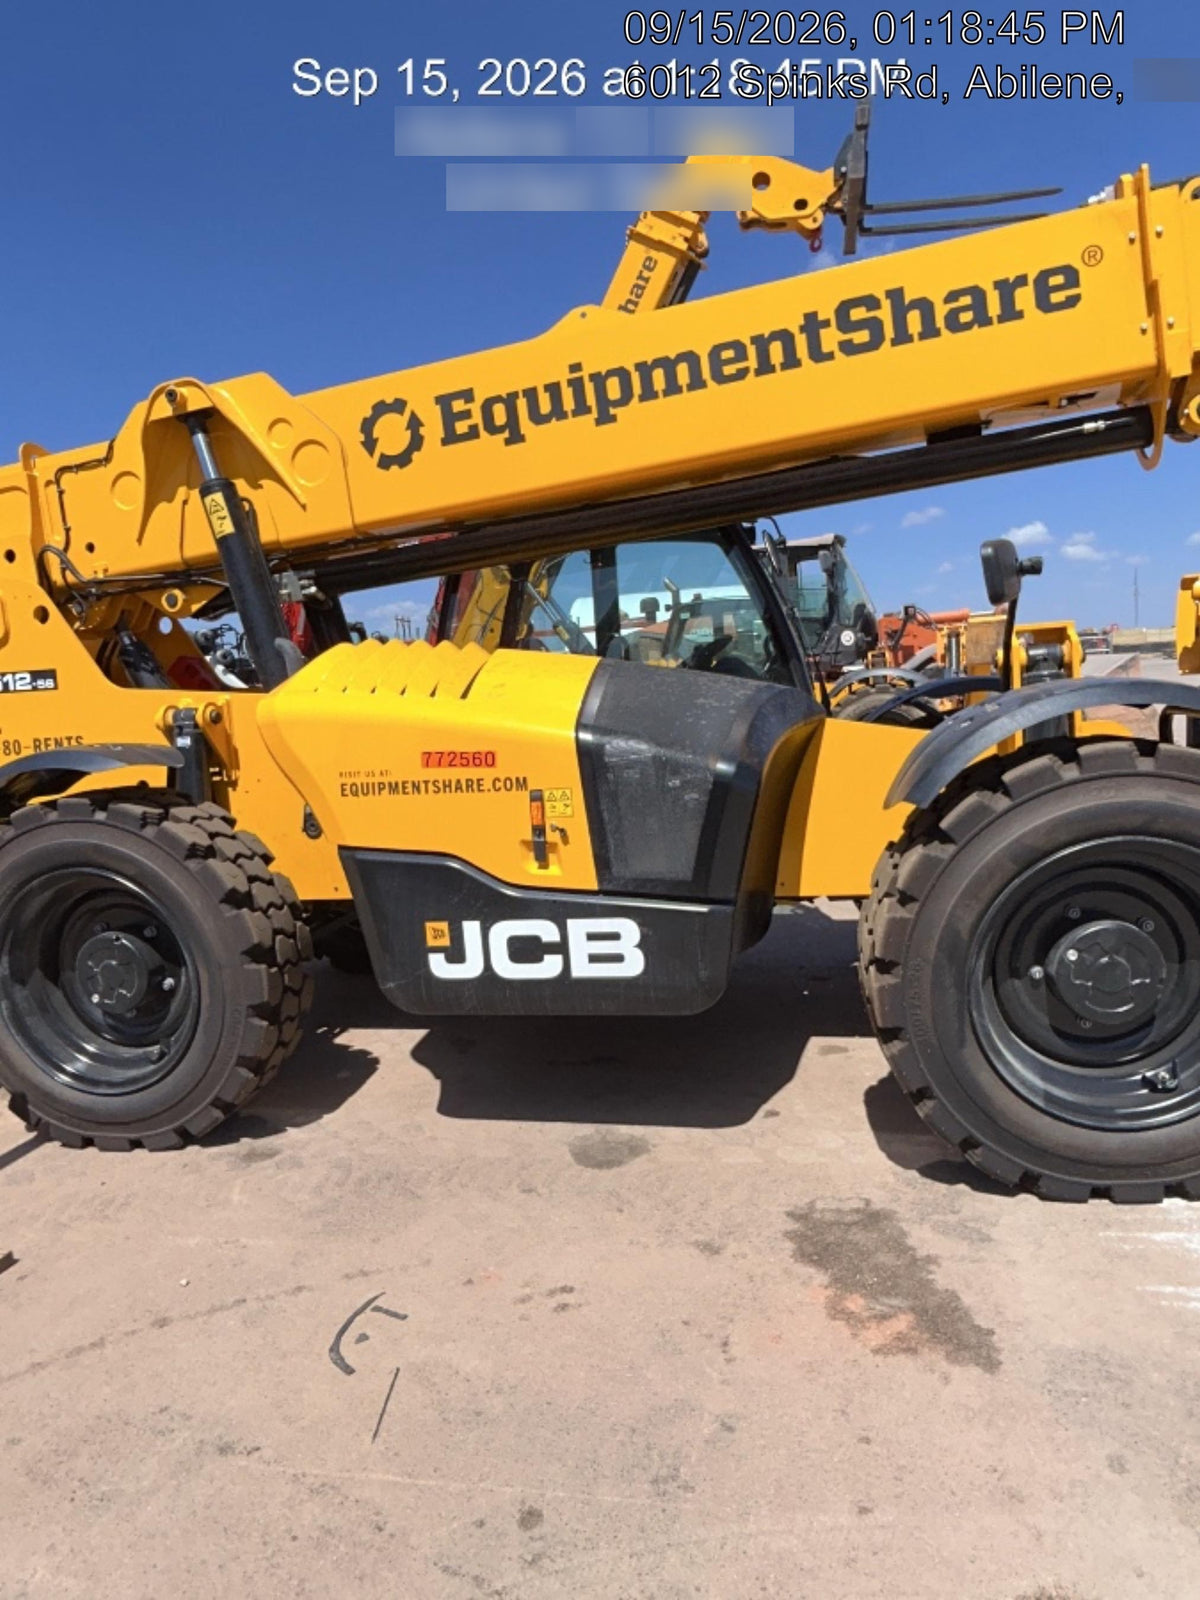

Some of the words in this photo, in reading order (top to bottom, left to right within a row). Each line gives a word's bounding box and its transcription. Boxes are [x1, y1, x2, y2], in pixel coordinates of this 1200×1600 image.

[422, 751, 496, 768] 772560
[340, 776, 529, 798] EQUIPMENTSHARE.COM
[428, 917, 645, 980] JCB
